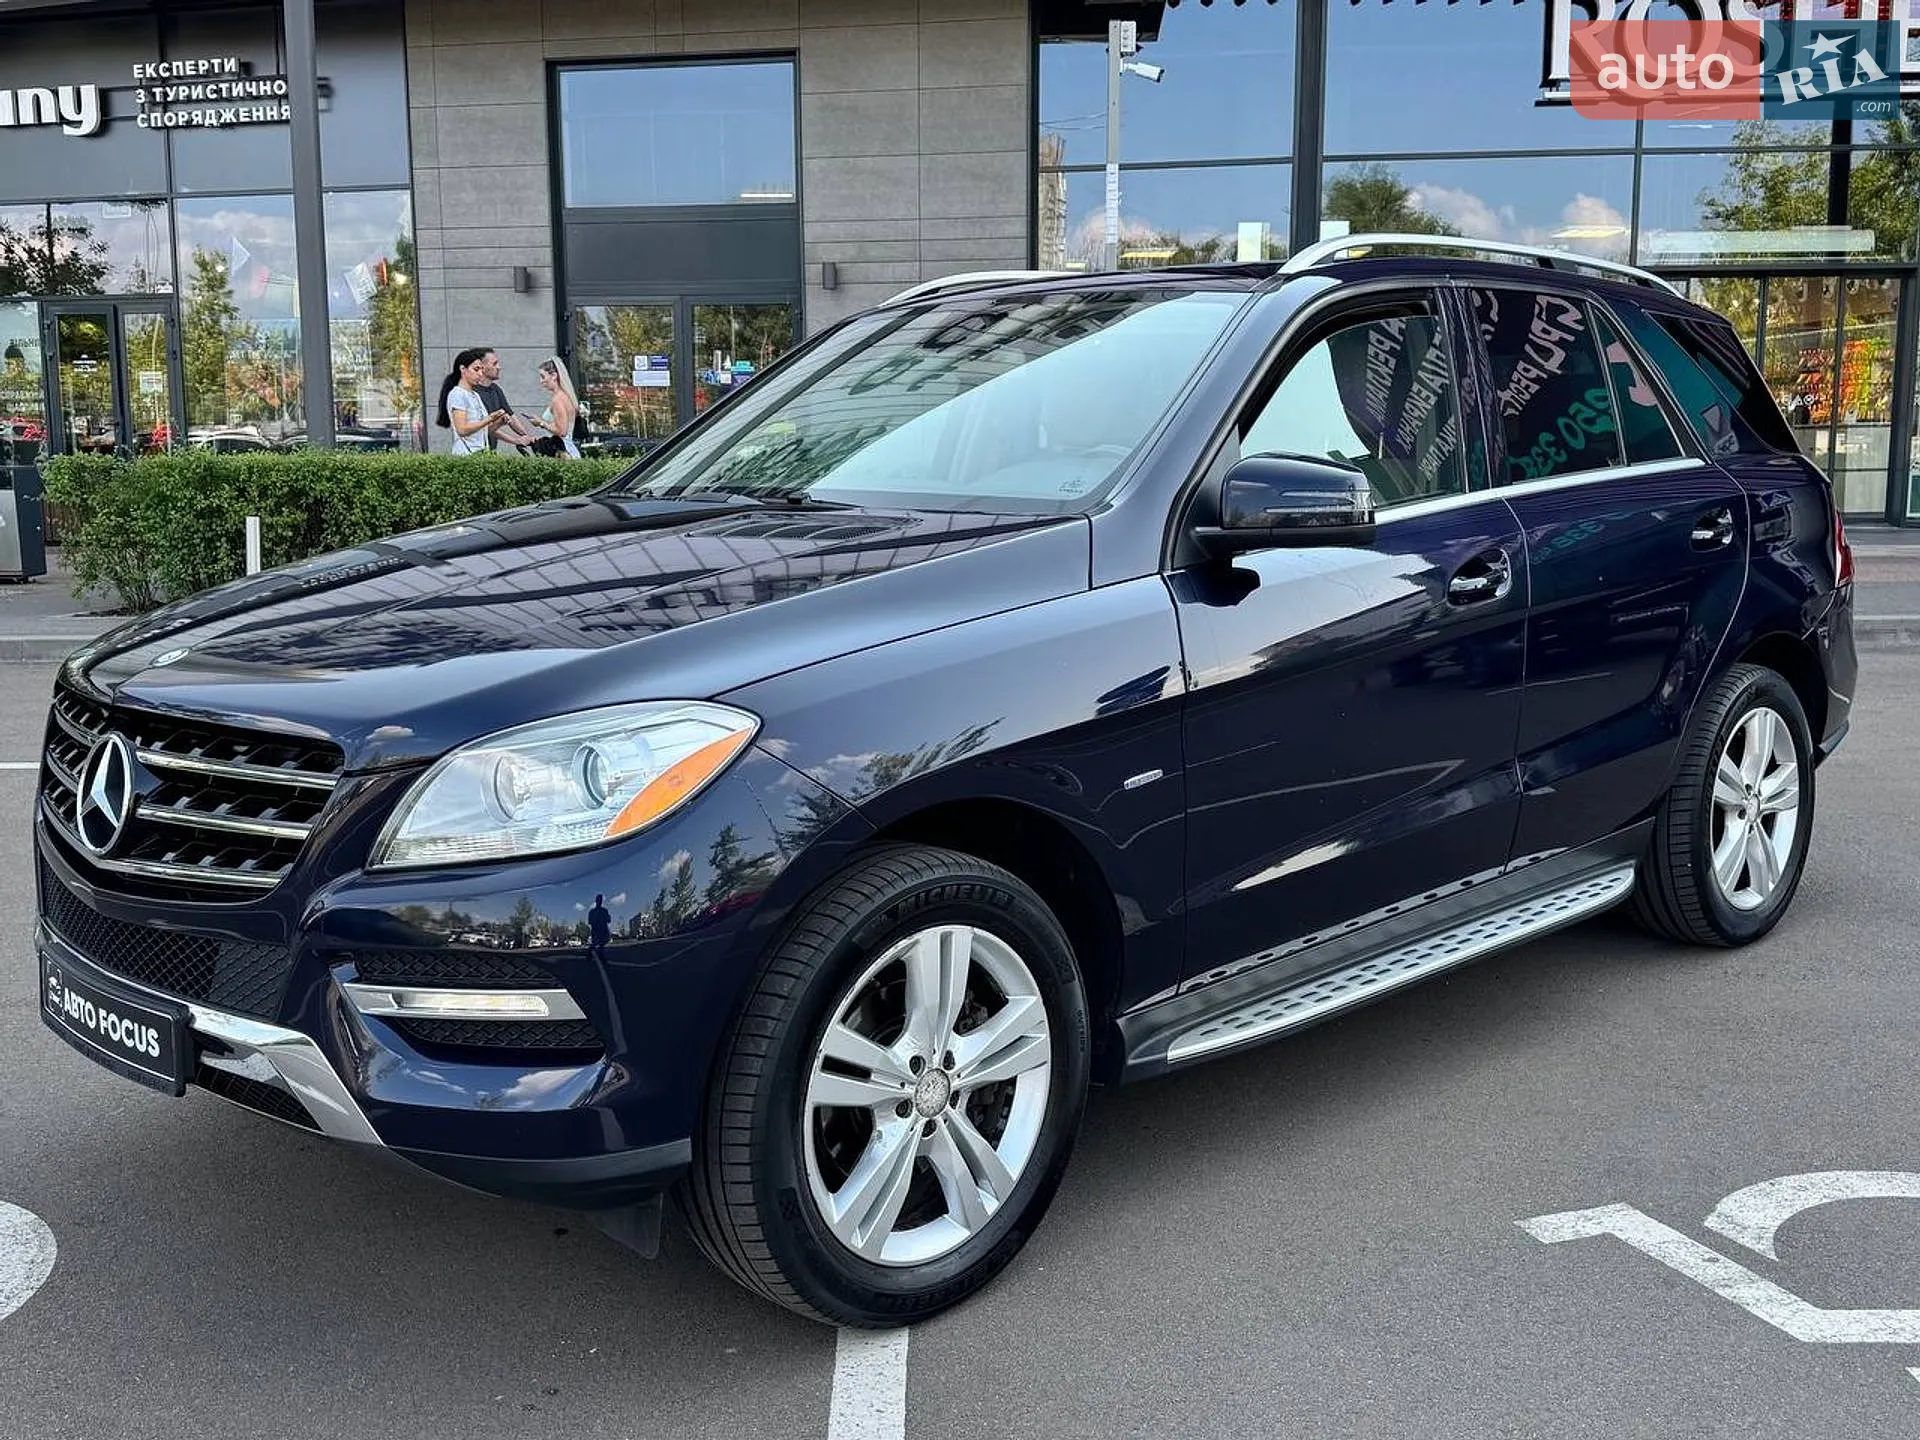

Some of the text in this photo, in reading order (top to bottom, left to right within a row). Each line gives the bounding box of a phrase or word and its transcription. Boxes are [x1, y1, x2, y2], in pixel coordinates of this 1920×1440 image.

[132, 57, 238, 79] ЕКСПЕРТИ
[152, 80, 288, 103] ТУРИСТИЧНО
[136, 104, 291, 128] СПОРЯДЖЕННЯ
[98, 1006, 161, 1058] FOCUS
